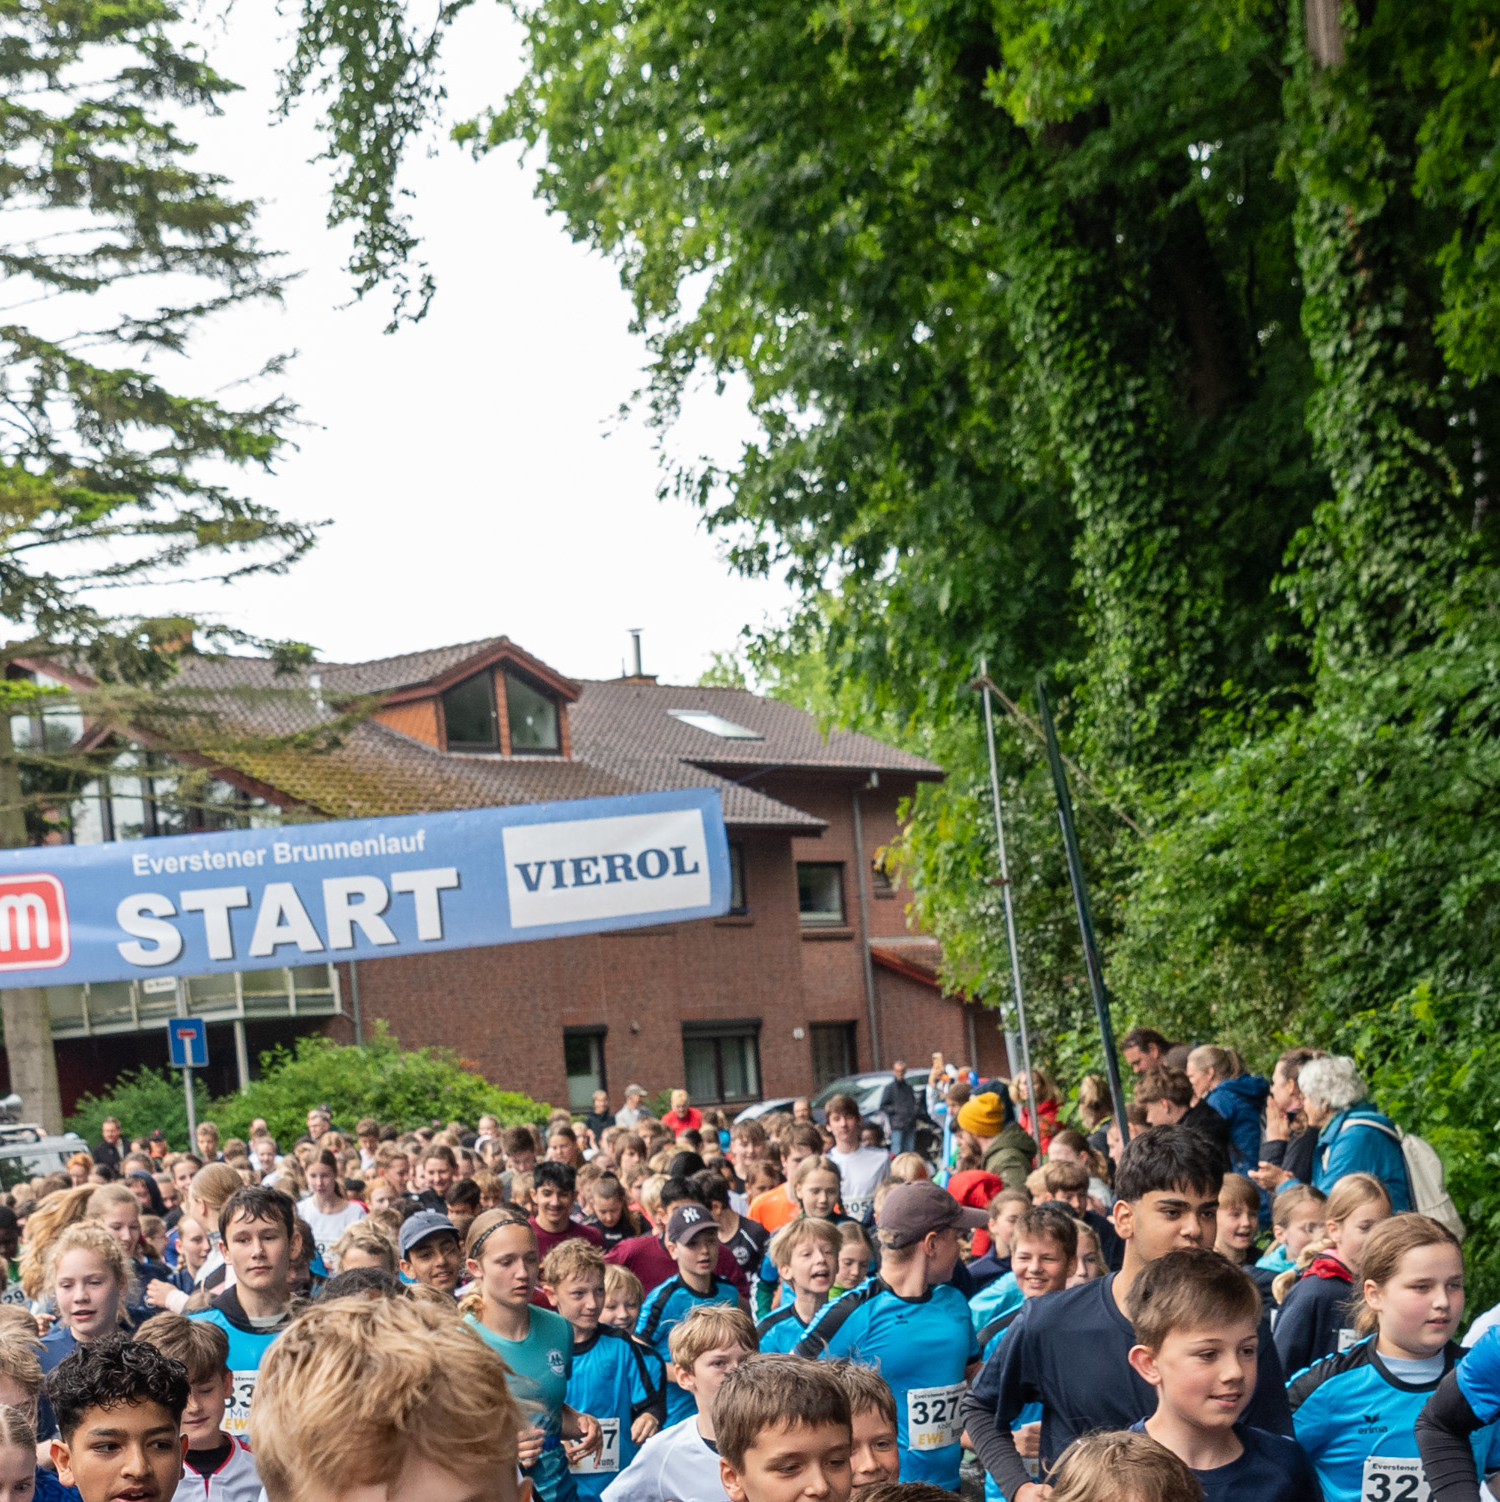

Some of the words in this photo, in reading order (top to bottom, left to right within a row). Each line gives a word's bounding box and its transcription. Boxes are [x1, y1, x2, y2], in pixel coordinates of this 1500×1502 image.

[132, 846, 266, 877] Everstener
[273, 829, 426, 865] Brunnenlauf
[513, 845, 700, 892] VIEROL
[115, 866, 460, 968] START
[225, 1419, 249, 1430] EW
[912, 1396, 960, 1425] 327
[1357, 1424, 1388, 1435] erima
[1371, 1463, 1419, 1471] Everstener
